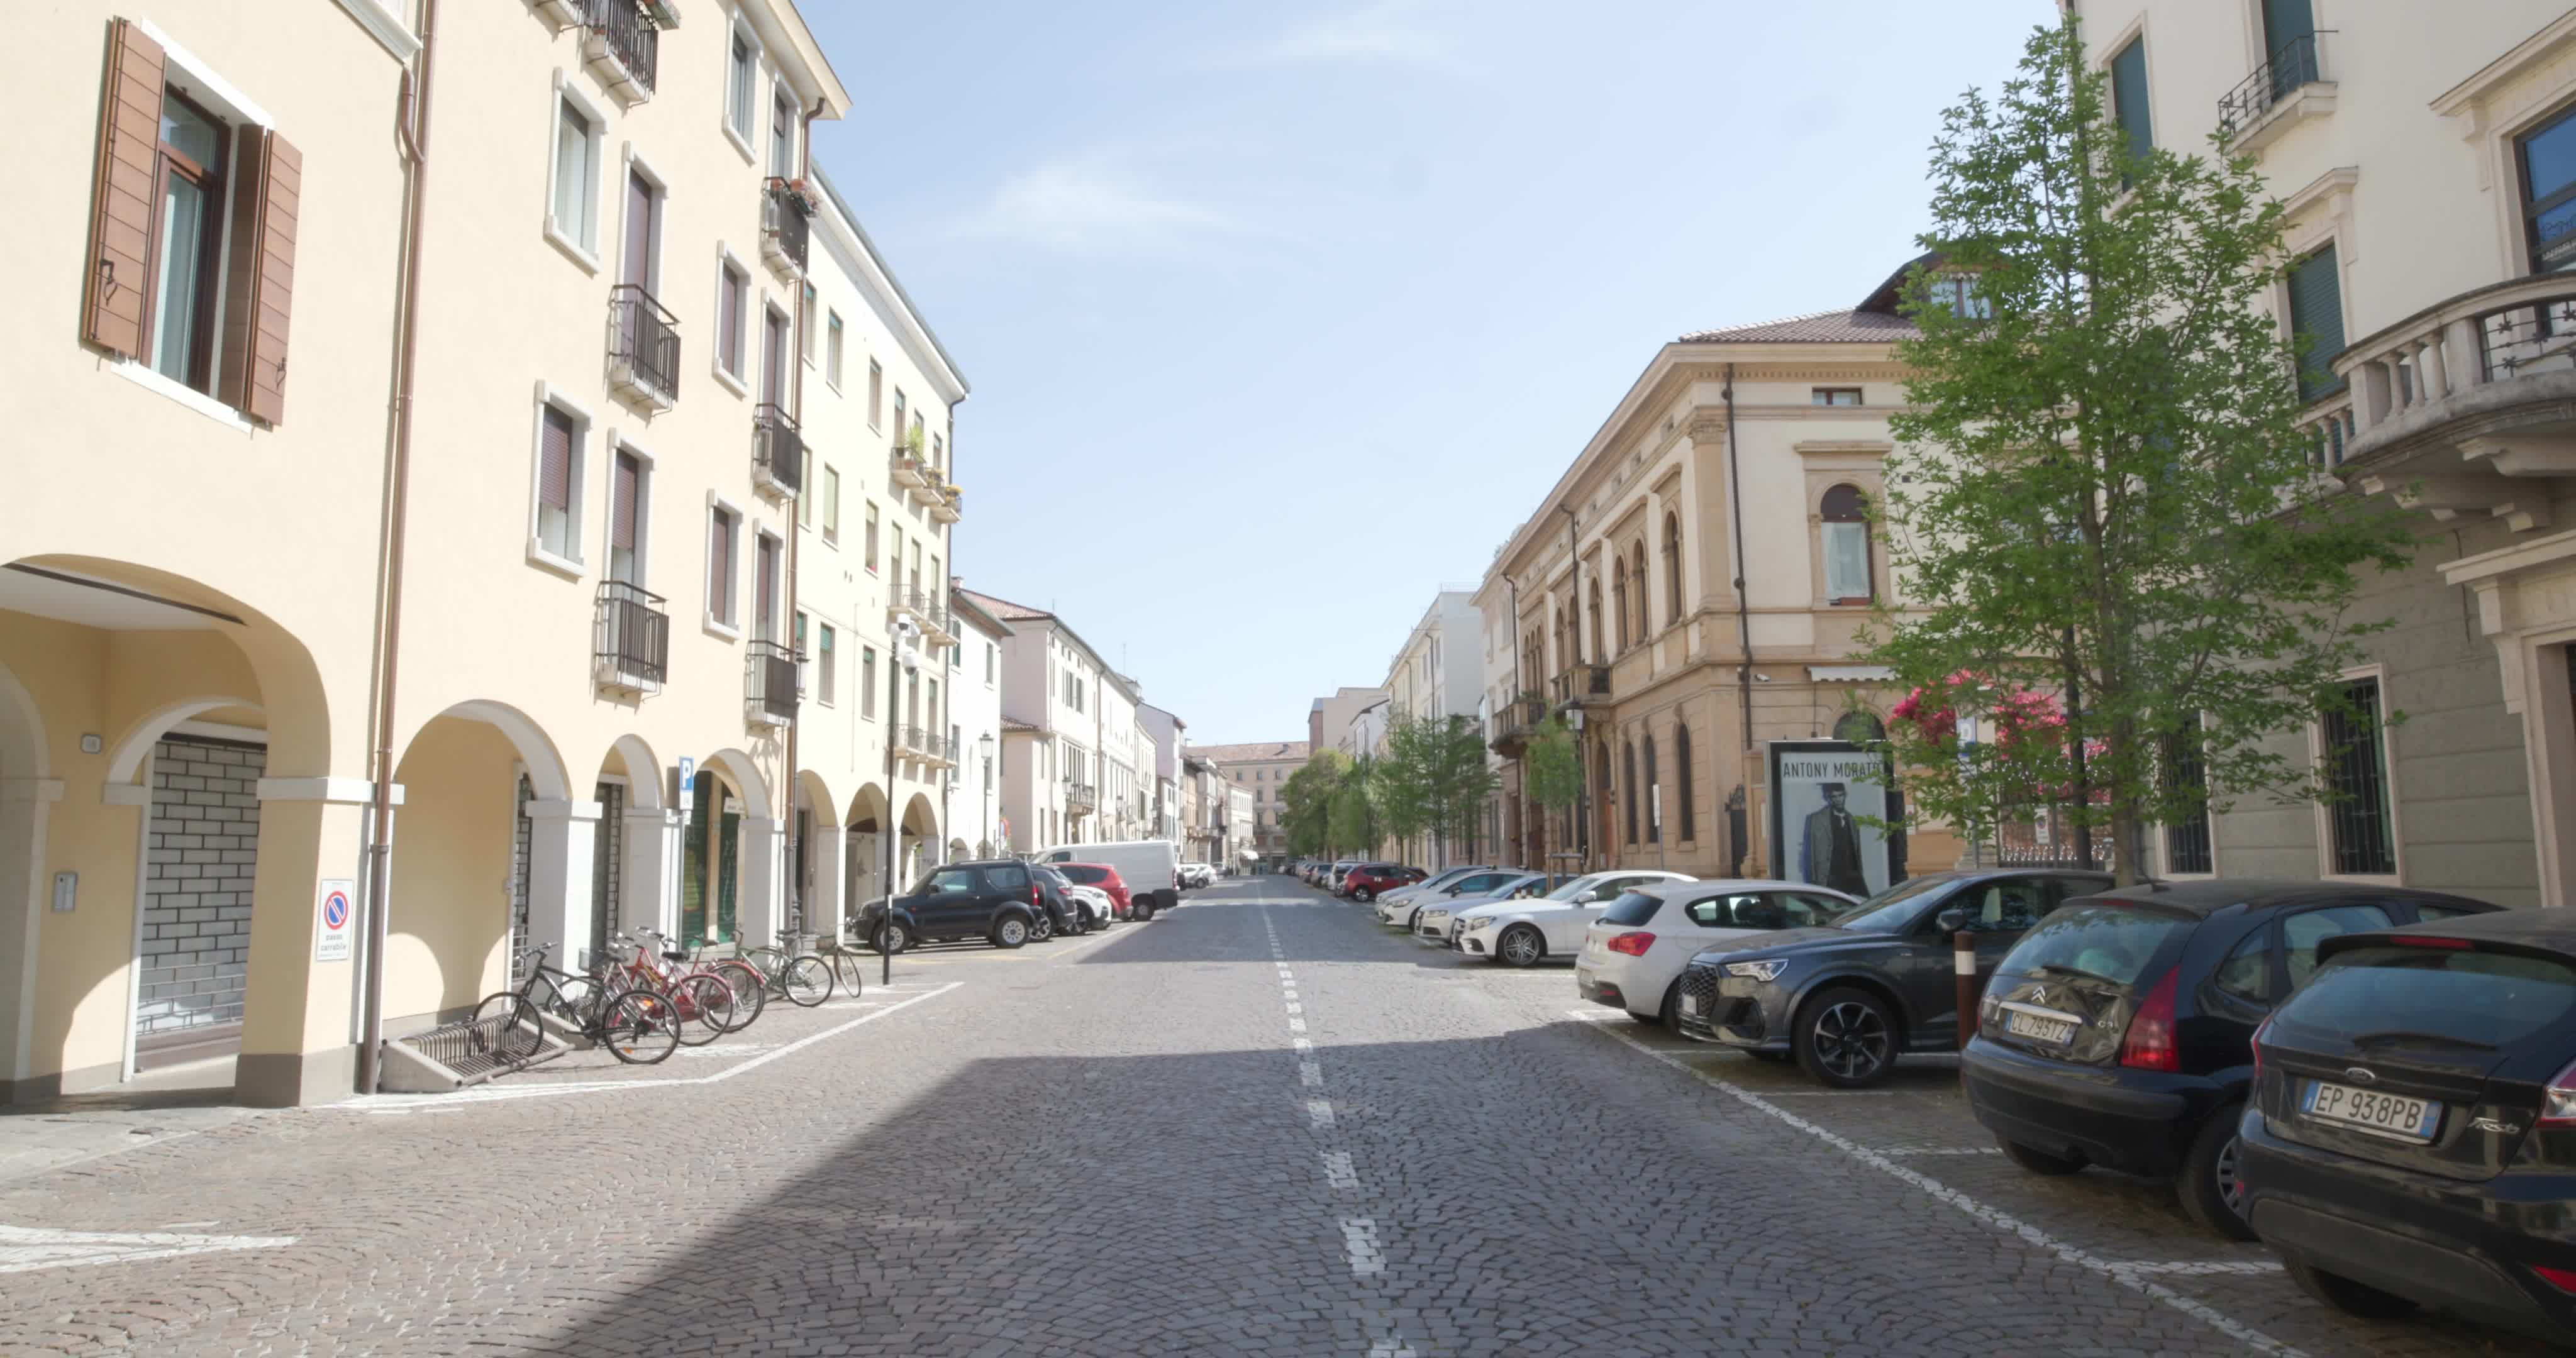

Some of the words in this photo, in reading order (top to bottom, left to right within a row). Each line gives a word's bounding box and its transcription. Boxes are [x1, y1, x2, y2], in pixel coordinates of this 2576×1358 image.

[682, 759, 691, 788] P
[1783, 762, 1828, 778] ANTONY
[2012, 1013, 2024, 1033] CL
[2315, 1085, 2344, 1113] EP
[2348, 1092, 2421, 1130] 938PB
